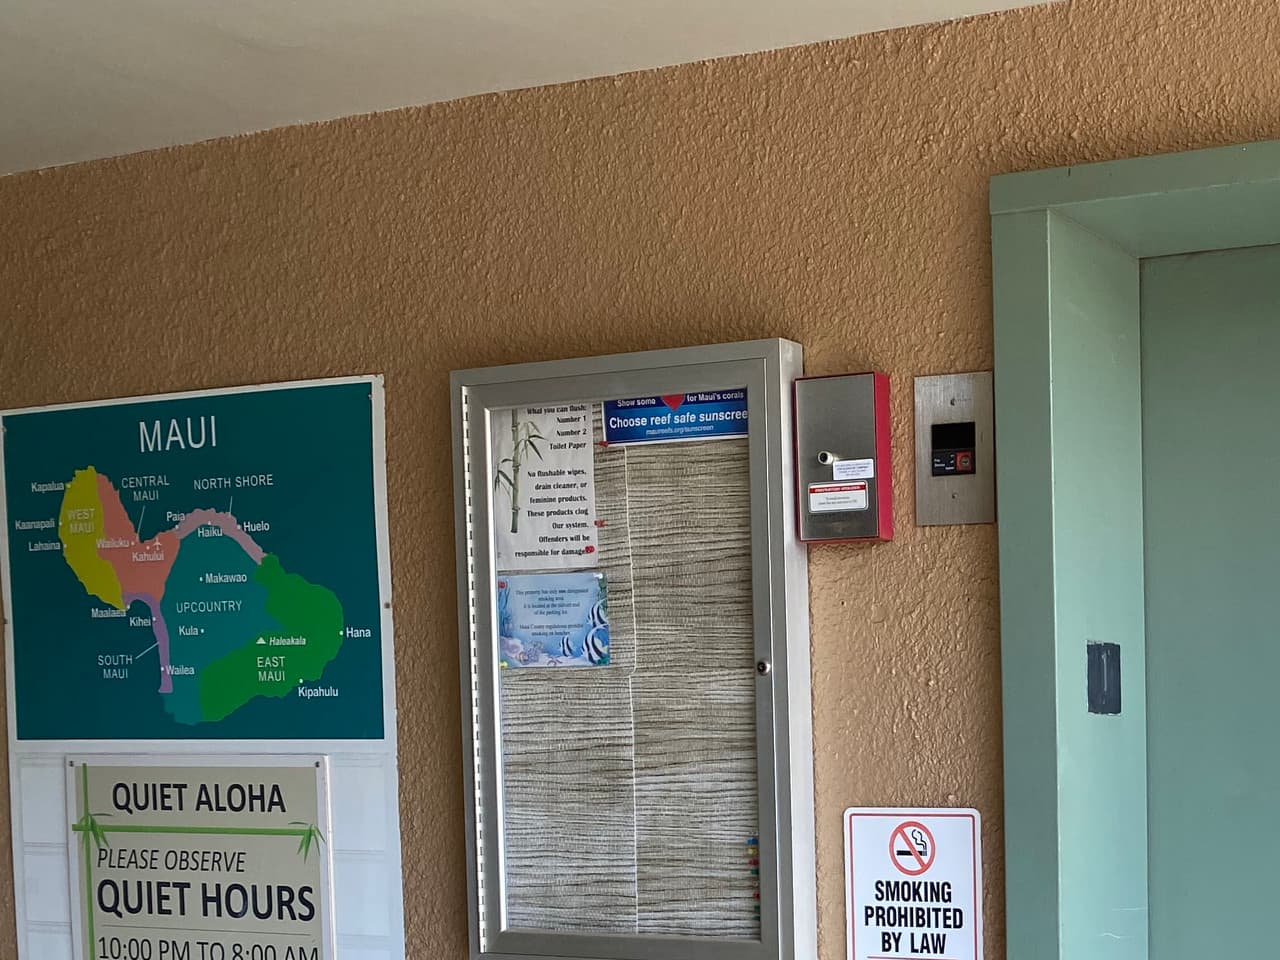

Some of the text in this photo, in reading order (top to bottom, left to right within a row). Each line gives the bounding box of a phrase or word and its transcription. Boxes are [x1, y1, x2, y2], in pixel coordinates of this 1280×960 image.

[687, 394, 697, 402] for
[698, 393, 721, 401] Maui's
[722, 391, 744, 400] corals
[609, 417, 648, 429] Choose
[650, 413, 672, 425] reef
[673, 412, 696, 424] safe
[139, 415, 216, 452] MAUI
[568, 442, 586, 450] Paper
[537, 469, 565, 477] flushable
[31, 481, 64, 493] Kapalua
[121, 475, 170, 488] CENTRAL
[193, 474, 273, 490] NORTH SHORE
[133, 490, 159, 501] MAUI
[530, 496, 556, 504] feminine
[67, 509, 95, 520] WEST
[166, 511, 185, 521] Paia
[546, 508, 573, 517] products
[575, 508, 589, 516] clog
[15, 518, 55, 531] Kaanapali
[69, 523, 94, 533] MAUI
[243, 521, 270, 533] Huelo
[198, 527, 223, 538] Haiku
[97, 538, 129, 548] Wailuku
[539, 535, 568, 543] Offenders
[28, 541, 60, 551] Lahaina
[132, 552, 164, 562] Kahului
[515, 549, 549, 558] responsible
[205, 573, 247, 583] Makawao
[176, 601, 242, 613] UPCOUNTRY
[91, 608, 126, 618] Maalaea
[130, 616, 151, 627] Kihei
[179, 625, 198, 636] Kula
[346, 627, 371, 638] Hana
[269, 636, 306, 646] Haleakala
[98, 655, 132, 666] SOUTH
[257, 656, 285, 668] EAST
[103, 669, 128, 679] MAUI
[166, 665, 195, 675] Wailea
[259, 670, 285, 682] MAUI
[298, 686, 338, 699] Kipahulu
[112, 782, 286, 815] QUIET ALOHA
[98, 848, 246, 873] PLEASE OBSERVE
[875, 880, 952, 903] SMOKING
[97, 879, 315, 921] QUIET HOURS
[864, 905, 963, 929] PROHIBITED
[98, 937, 152, 960] 10:00
[881, 931, 946, 955] BY LAW
